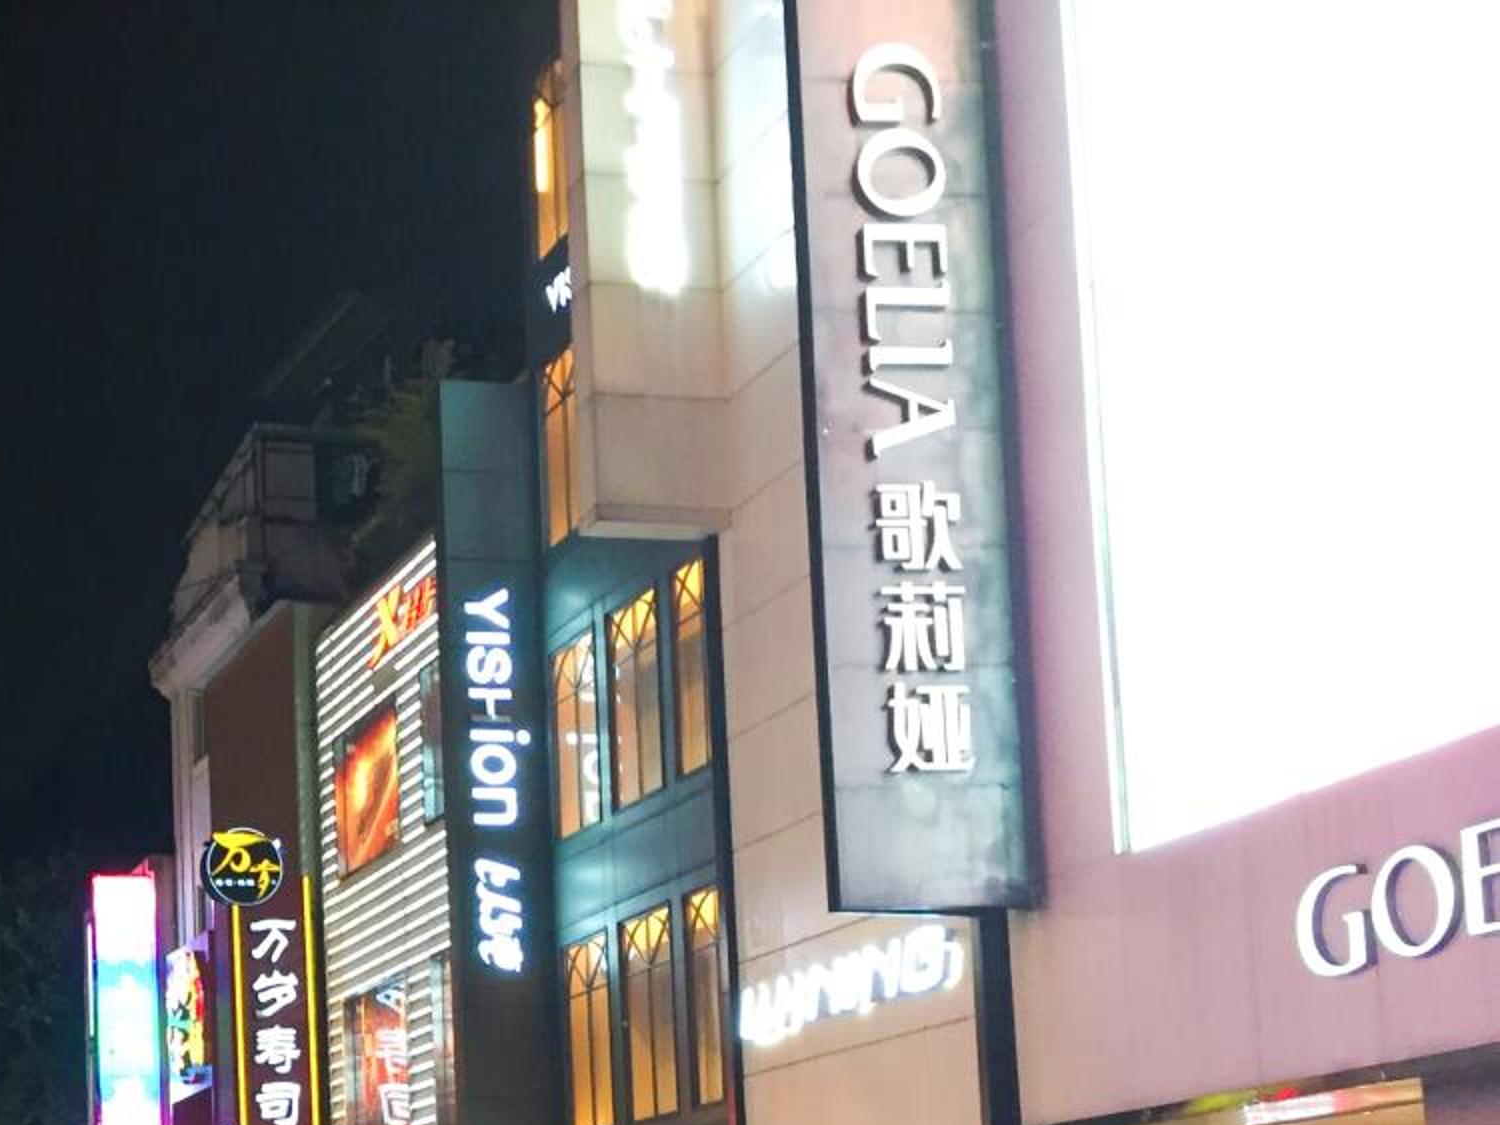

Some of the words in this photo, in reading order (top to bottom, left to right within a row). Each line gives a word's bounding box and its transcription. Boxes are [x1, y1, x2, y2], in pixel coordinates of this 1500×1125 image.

[852, 42, 957, 460] GOELIA
[876, 480, 976, 775] 歌莉娅
[1296, 816, 1500, 977] GOE
